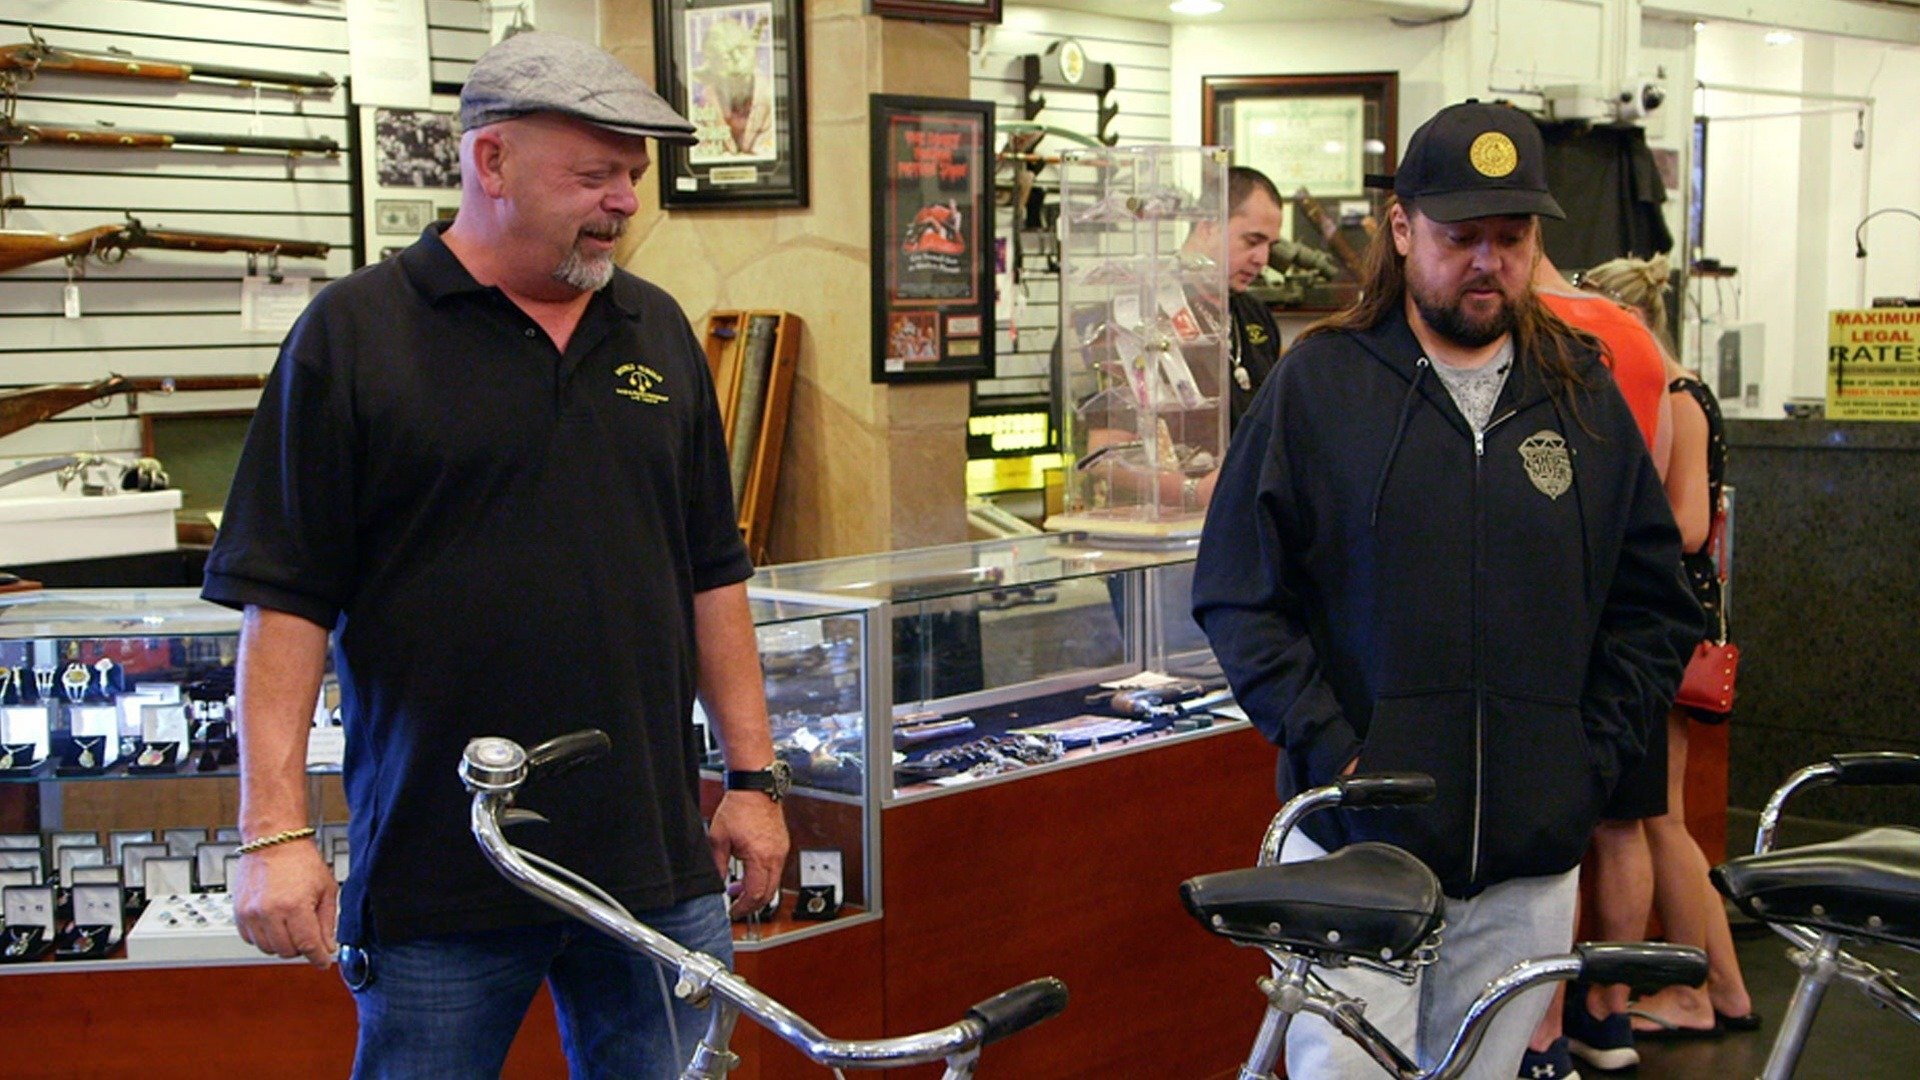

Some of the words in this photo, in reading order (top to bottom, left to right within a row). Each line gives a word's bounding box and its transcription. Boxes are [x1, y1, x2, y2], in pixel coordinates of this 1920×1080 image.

[1836, 313, 1920, 325] MAXIMU
[1851, 331, 1913, 342] LEGAL
[1829, 346, 1920, 362] RATE
